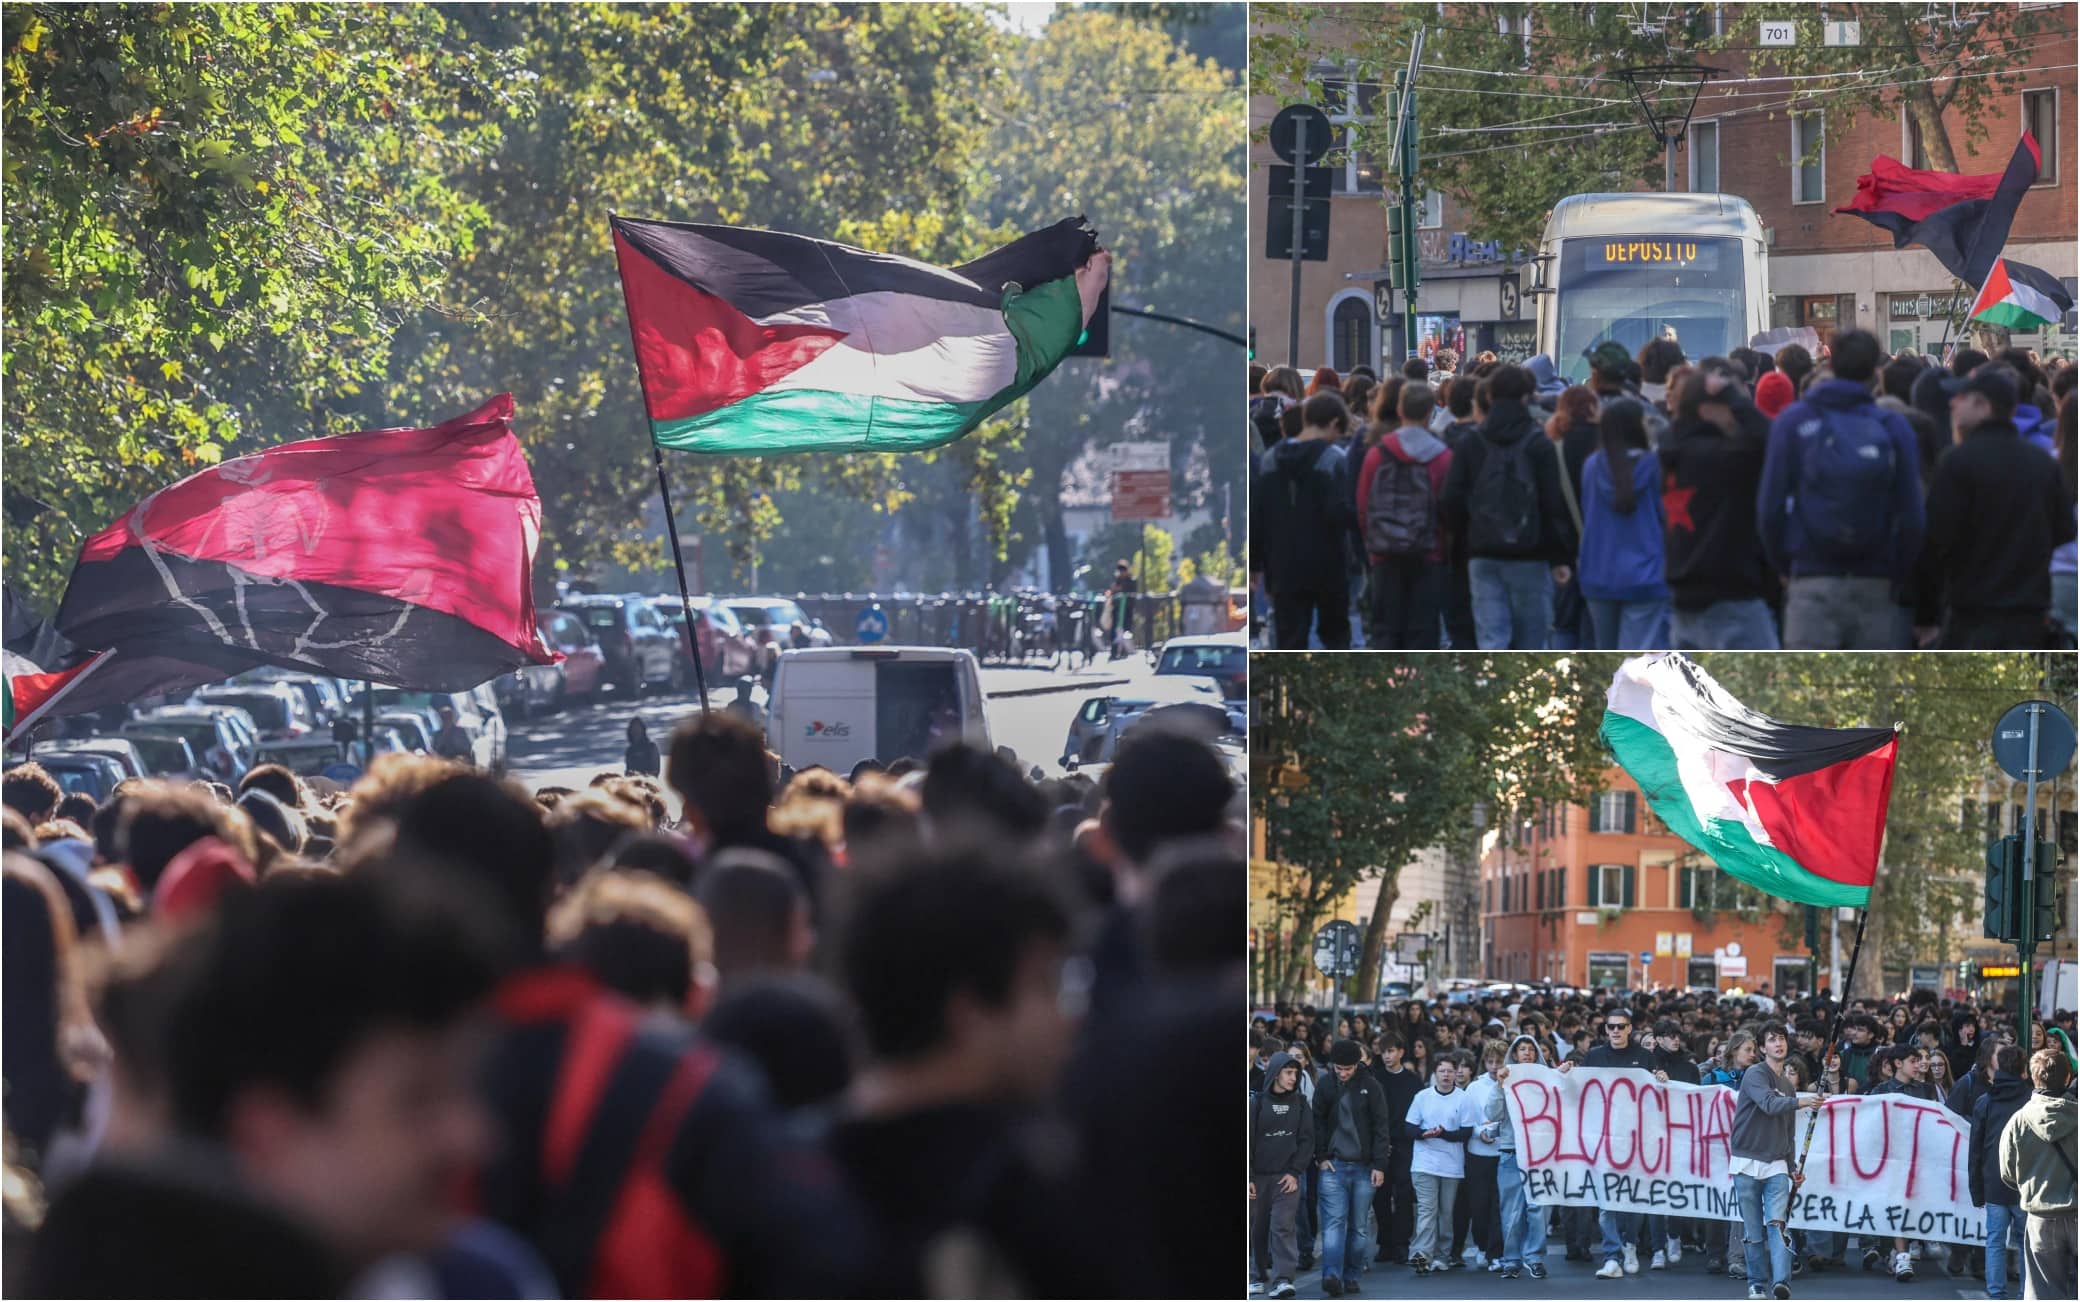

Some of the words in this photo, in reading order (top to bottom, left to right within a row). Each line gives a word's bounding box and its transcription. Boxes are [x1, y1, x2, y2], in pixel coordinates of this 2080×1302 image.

[1765, 28, 1788, 40] 701
[1605, 242, 1697, 262] DEPOSITO
[822, 721, 850, 737] elis
[1563, 1169, 1598, 1201] LA
[1602, 1172, 1740, 1217] PALESTINA
[1788, 1193, 1838, 1222] PER
[1844, 1200, 1876, 1231] LA
